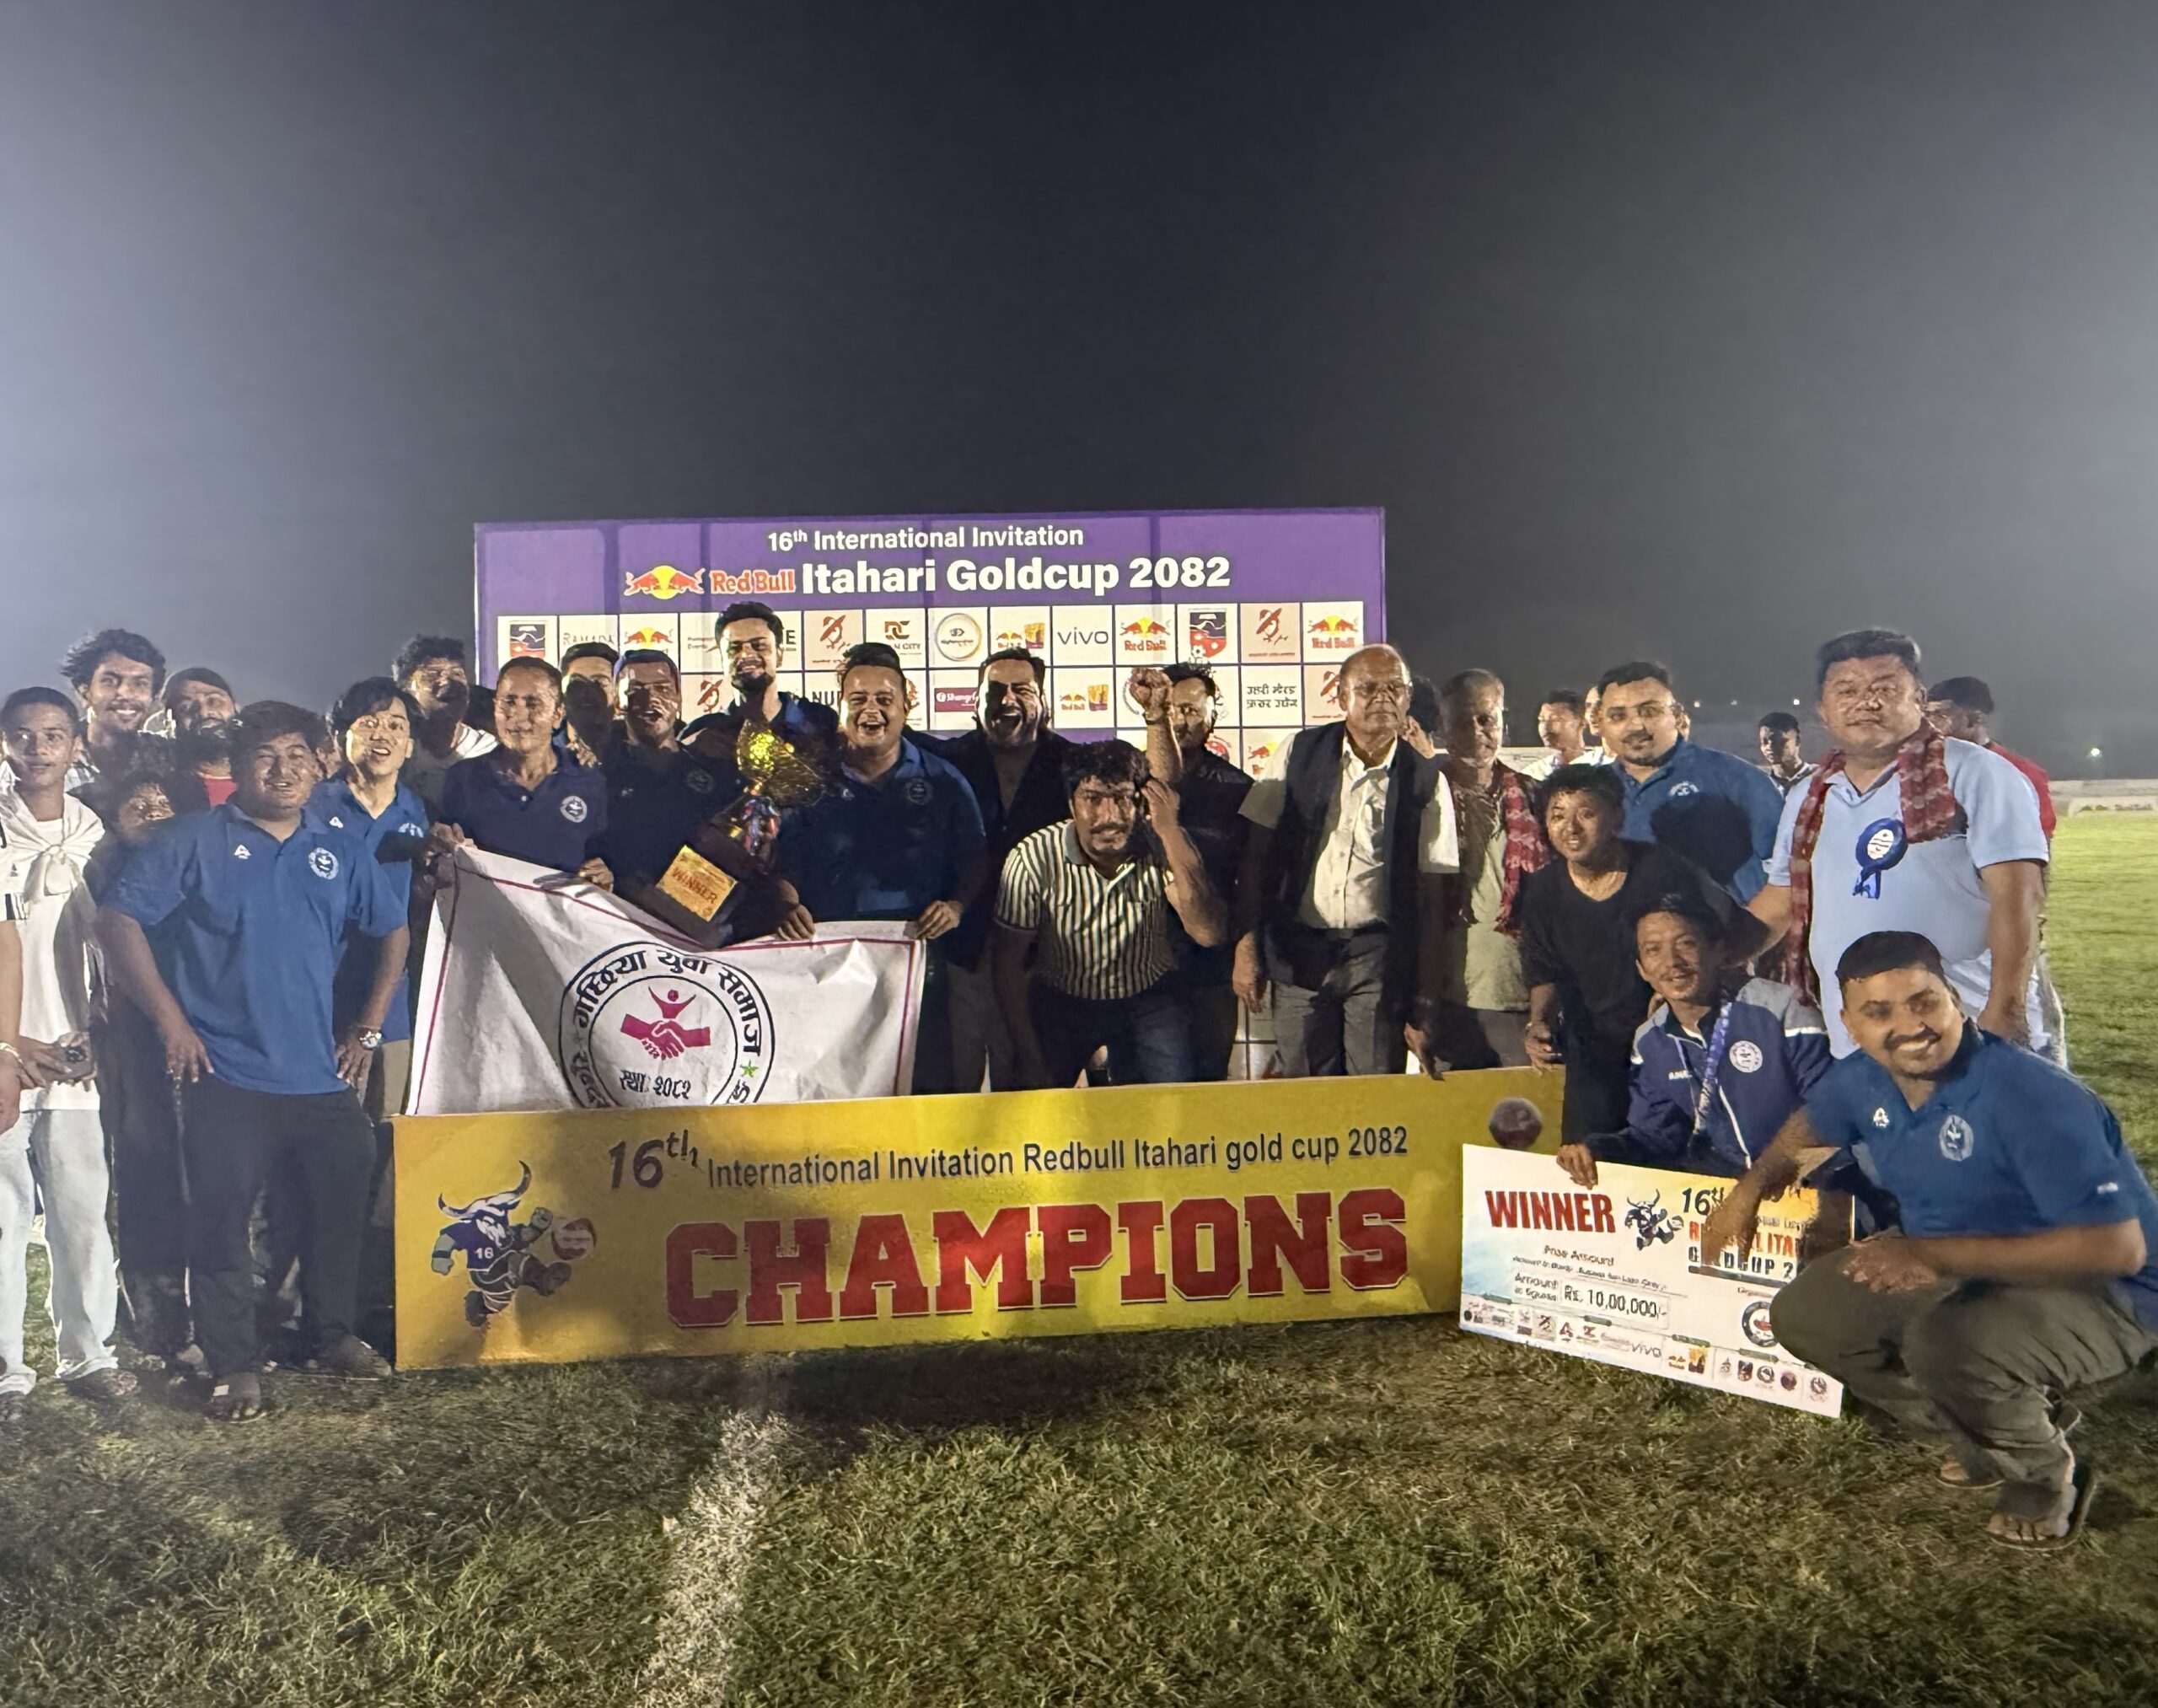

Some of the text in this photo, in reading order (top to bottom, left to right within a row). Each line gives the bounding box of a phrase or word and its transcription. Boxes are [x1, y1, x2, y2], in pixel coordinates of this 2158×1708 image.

[768, 524, 1085, 551] 16th International Invitation
[803, 560, 937, 595] Itahari
[947, 556, 1120, 597] Goldcup
[1129, 556, 1231, 589] 2082
[1057, 626, 1109, 645] vivo
[656, 949, 713, 975] युवा
[718, 966, 762, 1057] समाज
[707, 1152, 878, 1189] International
[889, 1144, 1014, 1179] Invitation
[1023, 1139, 1125, 1173] Redbull
[1135, 1136, 1218, 1167] Itahari
[1226, 1131, 1282, 1172] gold
[1291, 1134, 1340, 1165] cup
[1349, 1125, 1409, 1157] 2082
[1484, 1190, 1616, 1233] WINNER
[665, 1187, 1409, 1327] CHAMPIONS
